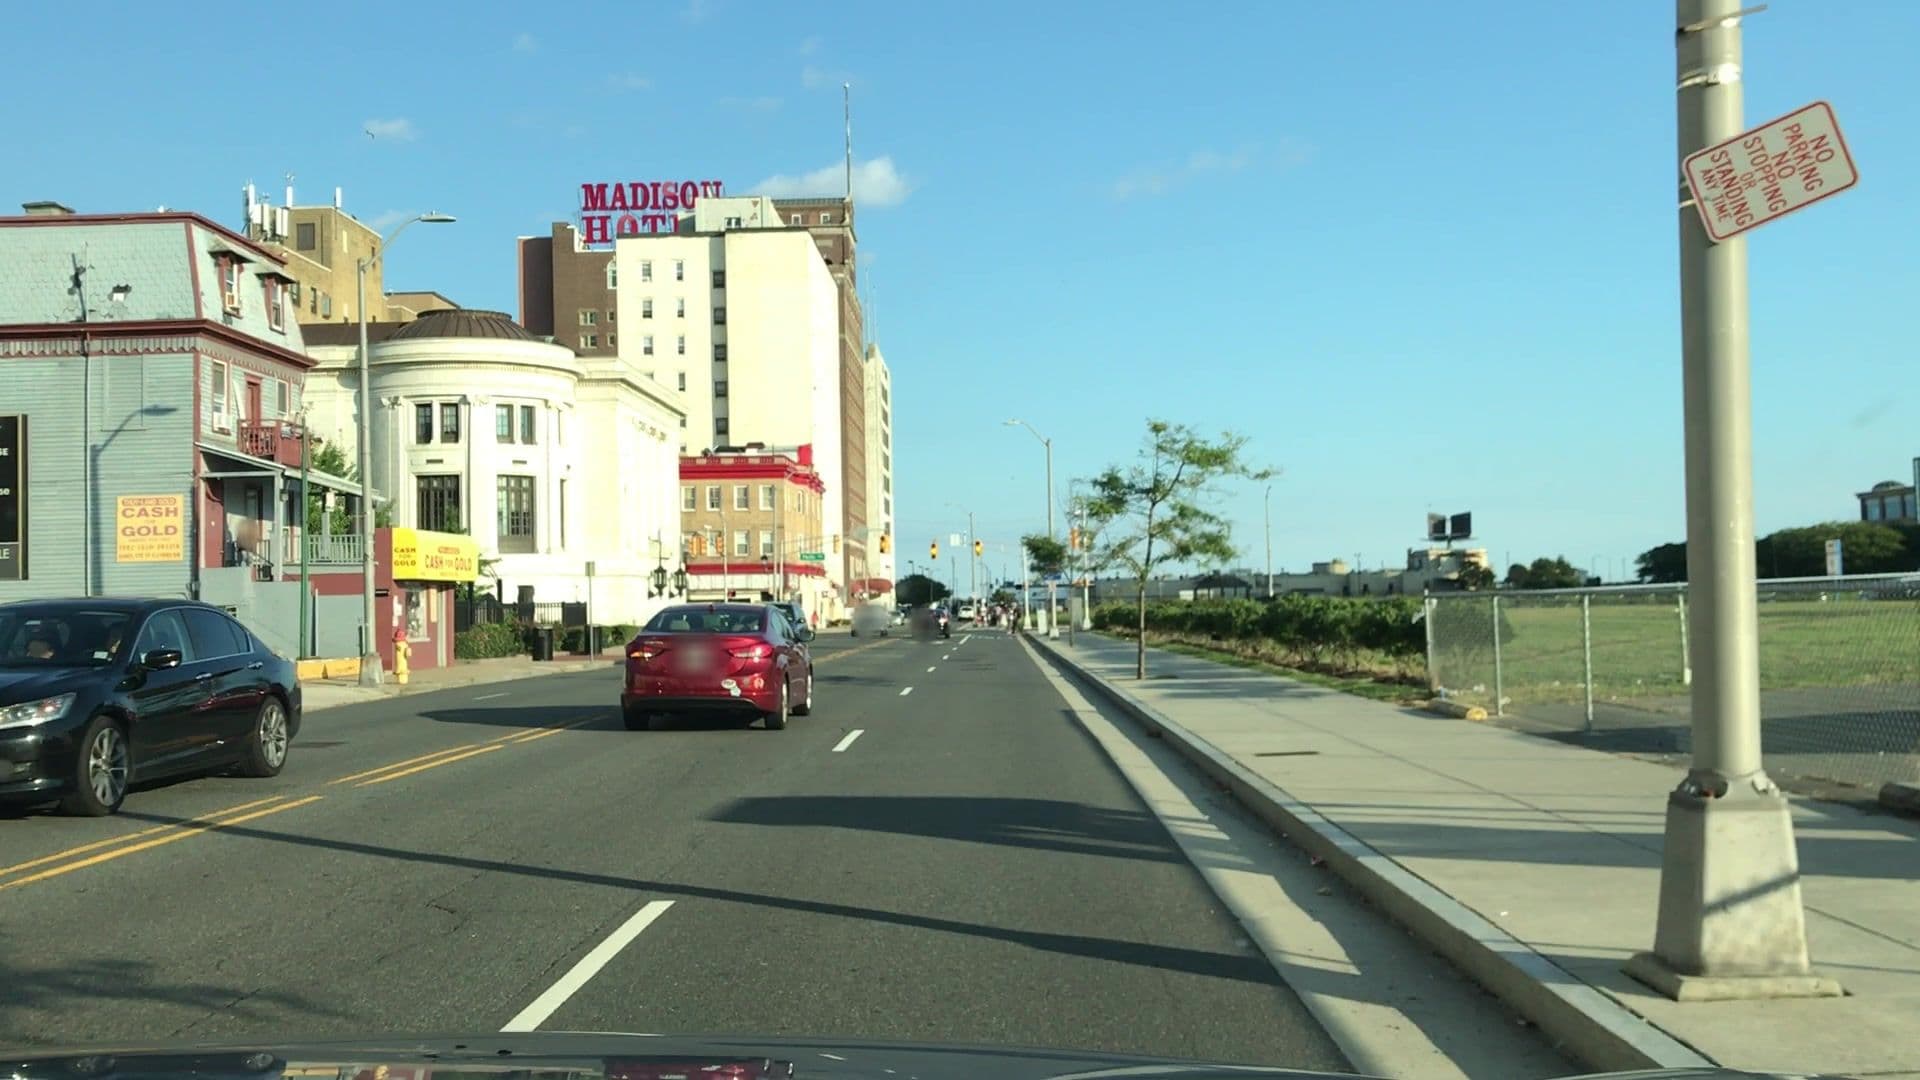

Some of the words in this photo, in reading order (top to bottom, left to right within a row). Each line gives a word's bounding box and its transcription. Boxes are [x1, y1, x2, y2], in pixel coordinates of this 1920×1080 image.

[1783, 122, 1824, 192] PARKING
[1809, 134, 1835, 163] NO
[1743, 136, 1788, 213] STOPPING
[1771, 151, 1796, 180] NO
[1710, 149, 1755, 226] STANDING
[1739, 171, 1757, 190] OR
[581, 181, 722, 211] MADISON
[1701, 169, 1719, 191] ANY
[1711, 194, 1733, 223] TIME
[121, 507, 178, 519] CASH
[121, 525, 178, 537] GOLD
[424, 554, 444, 569] CASH
[454, 557, 472, 571] GOLD
